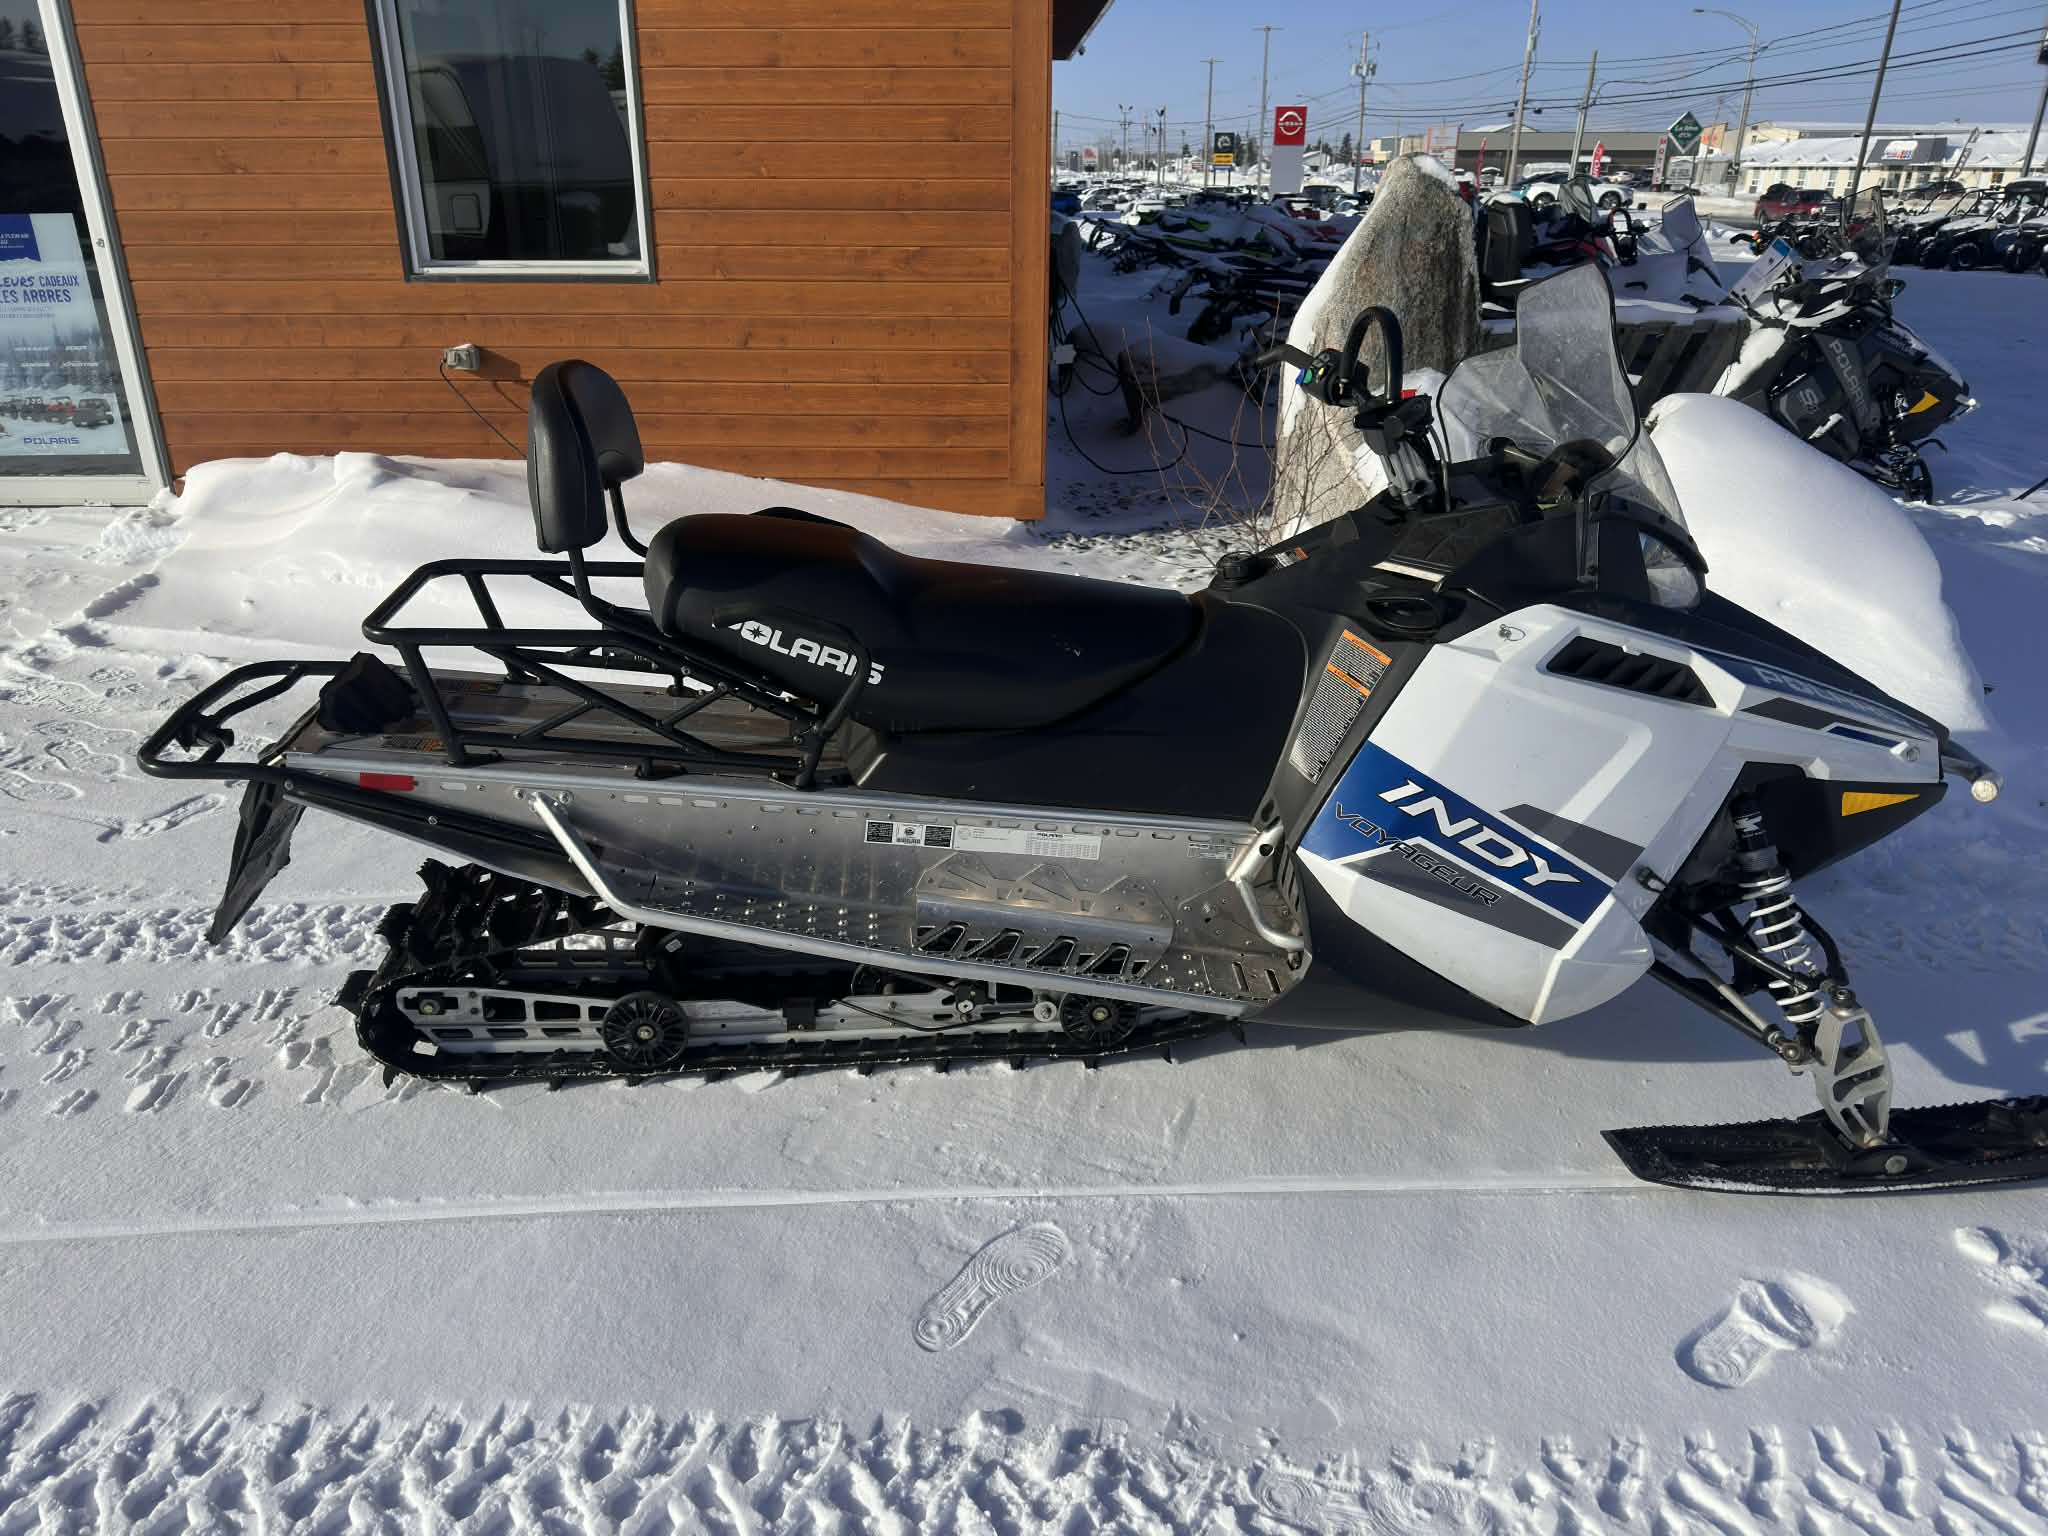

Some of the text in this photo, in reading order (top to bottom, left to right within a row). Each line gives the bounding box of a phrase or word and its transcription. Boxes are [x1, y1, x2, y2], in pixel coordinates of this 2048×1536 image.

[23, 289, 72, 304] ARBRES
[39, 275, 80, 287] CADEAUX
[24, 437, 80, 445] POLARIS
[728, 620, 885, 685] OLARIS
[1377, 779, 1583, 887] INDY
[1335, 801, 1501, 908] VOYAGEUR
